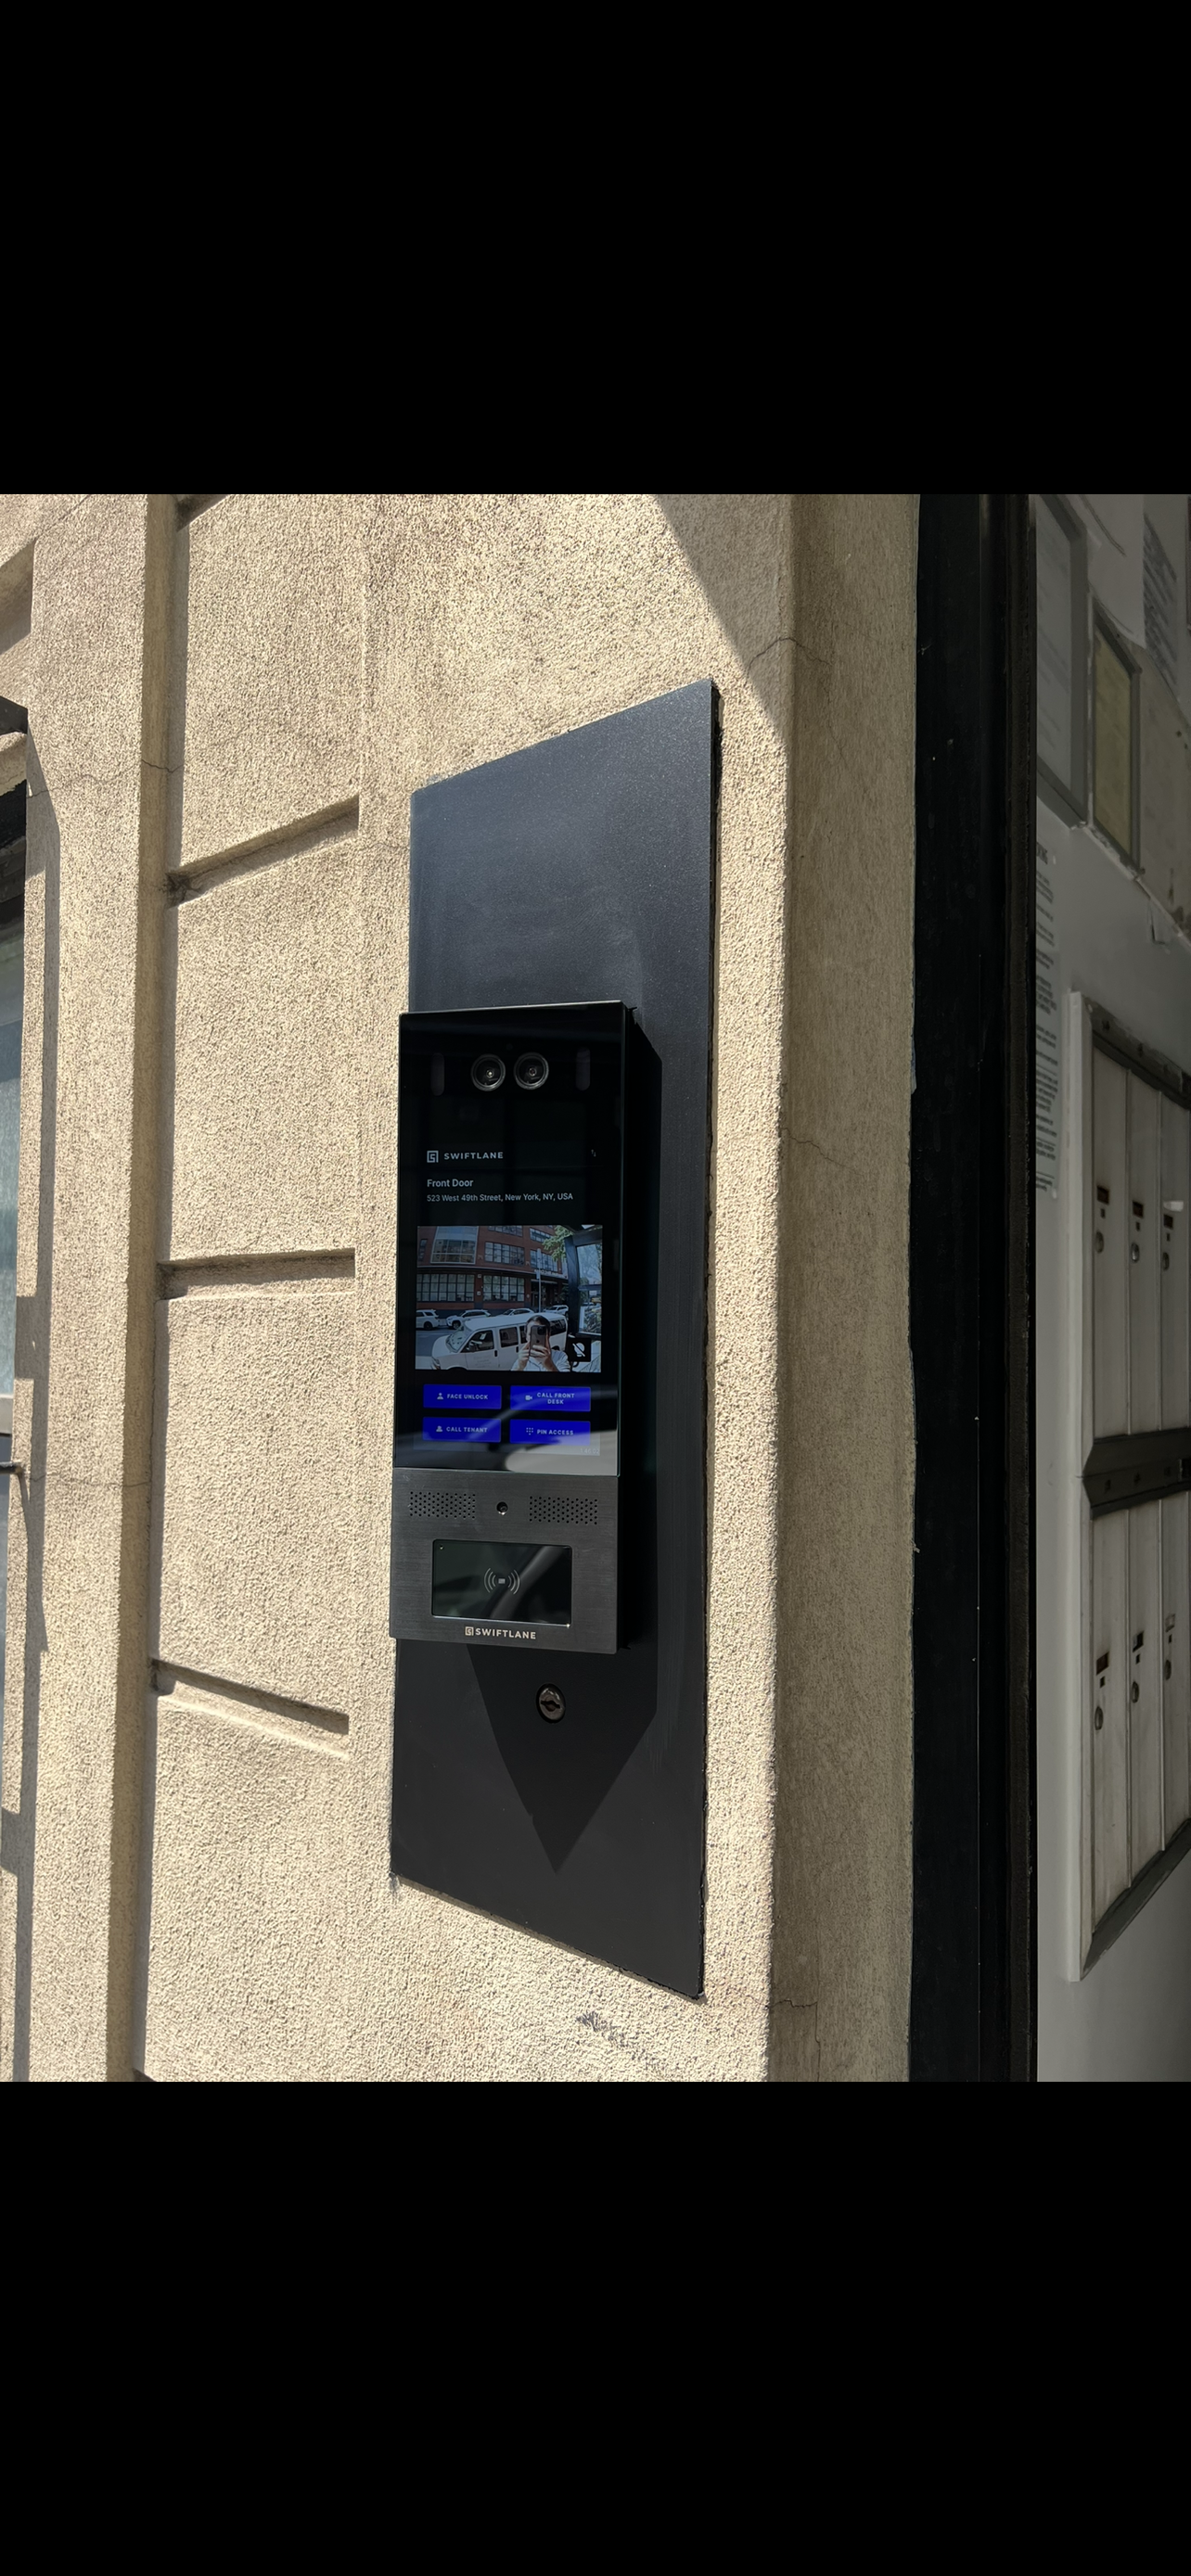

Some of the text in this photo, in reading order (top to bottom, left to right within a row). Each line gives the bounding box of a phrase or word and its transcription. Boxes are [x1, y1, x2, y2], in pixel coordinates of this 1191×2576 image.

[443, 1152, 504, 1160] SWIFTLANE
[452, 1179, 473, 1187] Door
[480, 1193, 503, 1202] Street,
[523, 1193, 541, 1202] York,
[475, 1628, 536, 1639] SWIFTLANE
